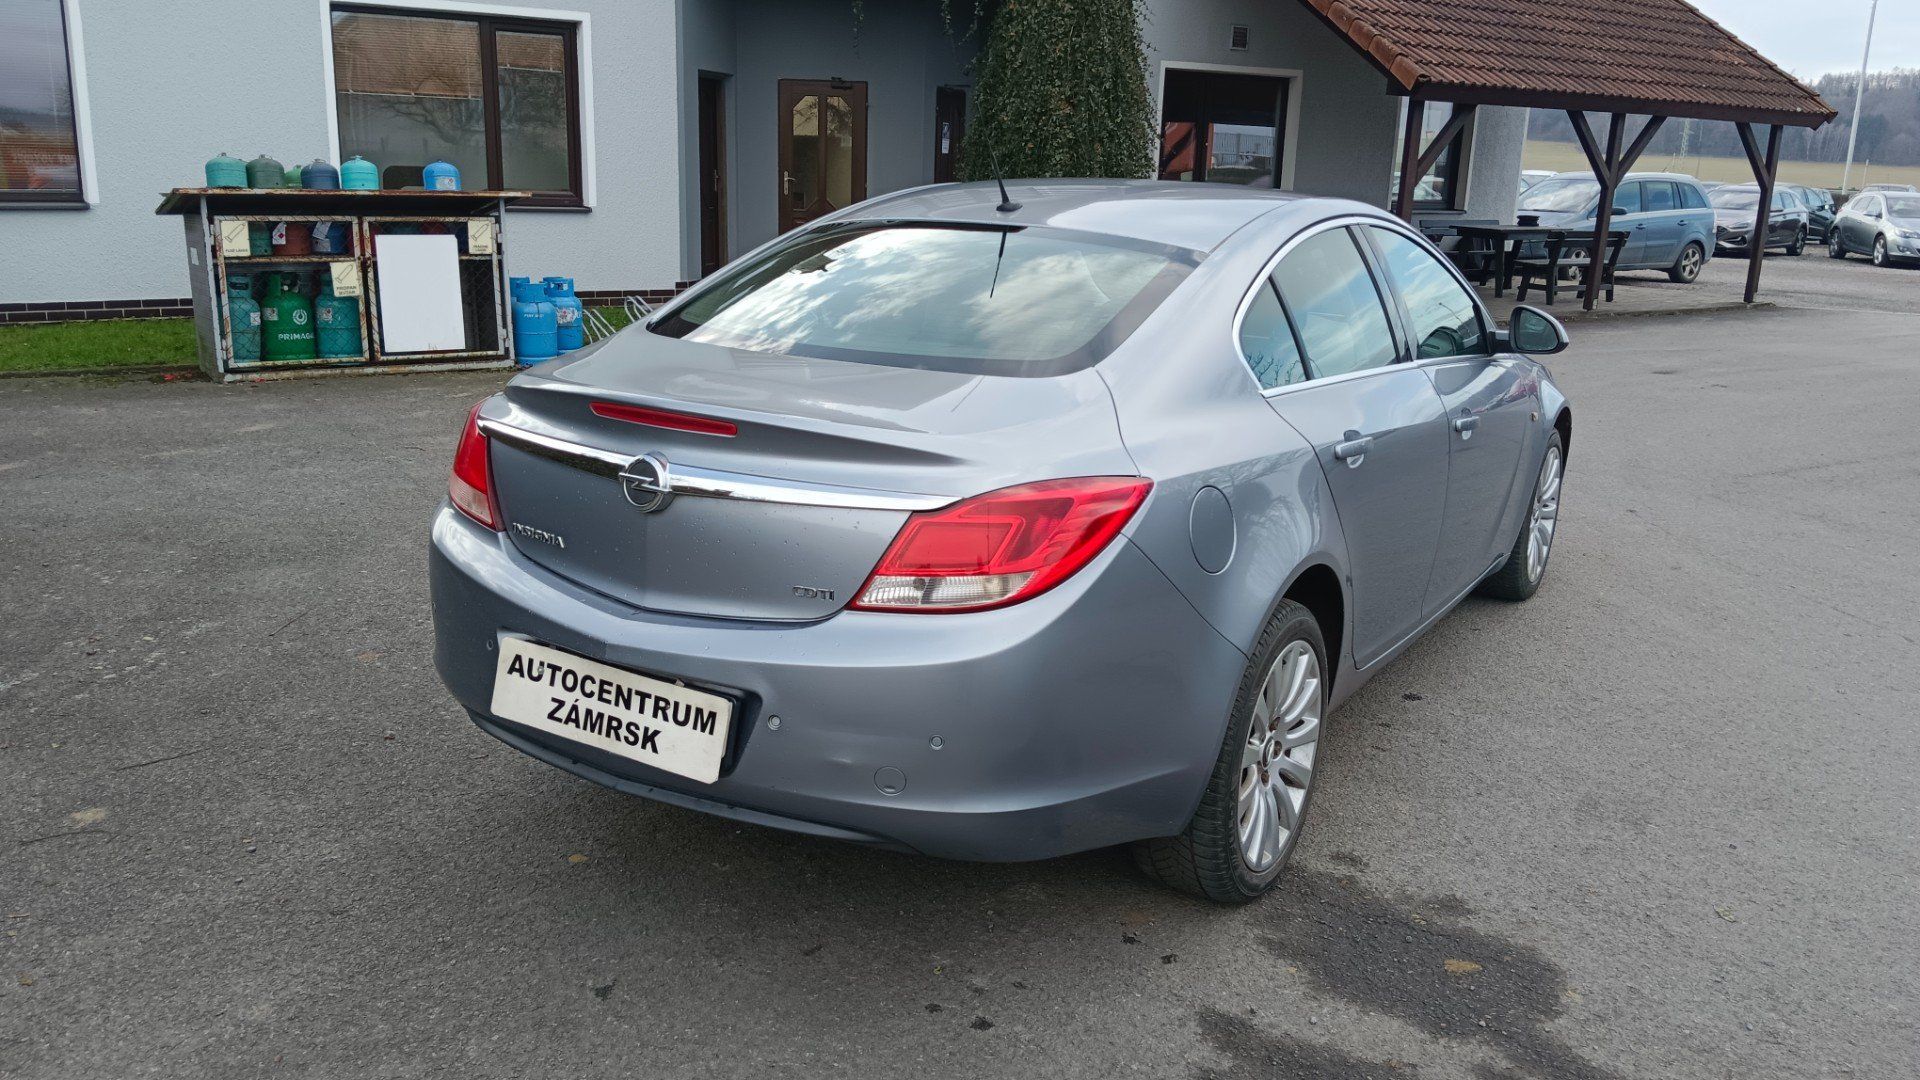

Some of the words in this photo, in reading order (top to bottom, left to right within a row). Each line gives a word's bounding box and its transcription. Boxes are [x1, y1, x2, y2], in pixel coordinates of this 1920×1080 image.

[512, 522, 565, 549] INSIGNIA
[792, 585, 835, 601] CDTI
[507, 653, 717, 735] AUTOCENTRUM
[547, 697, 662, 754] ZÁMRSK
